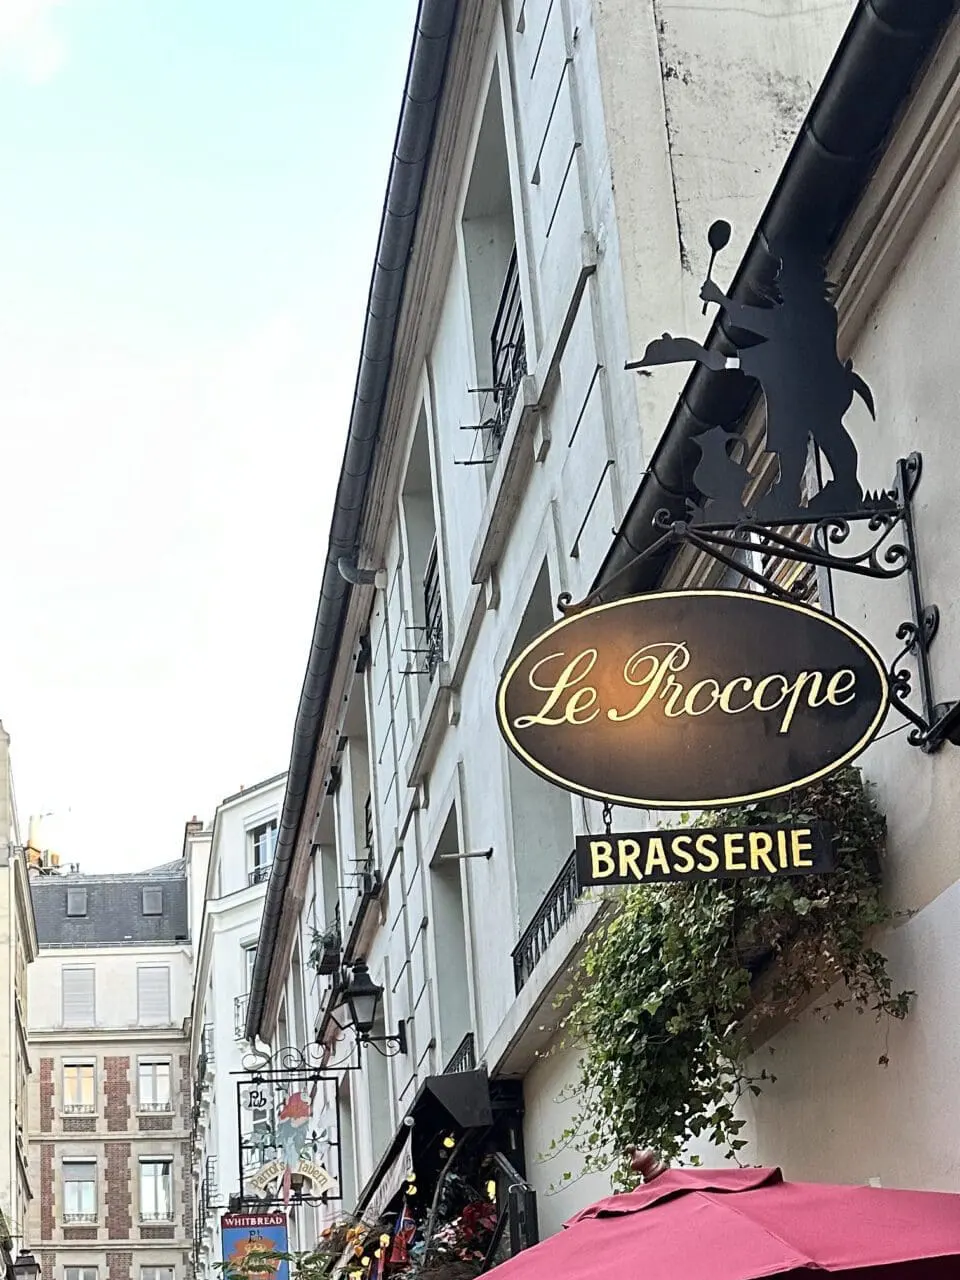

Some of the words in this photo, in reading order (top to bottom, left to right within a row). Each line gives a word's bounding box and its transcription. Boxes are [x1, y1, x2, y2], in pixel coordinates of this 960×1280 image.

[514, 648, 601, 729] Le
[607, 641, 856, 734] Procope
[589, 828, 814, 881] BRASSERIE
[248, 1090, 267, 1108] Pub
[297, 1160, 328, 1187] Tavern
[224, 1216, 283, 1226] WHITBREAD
